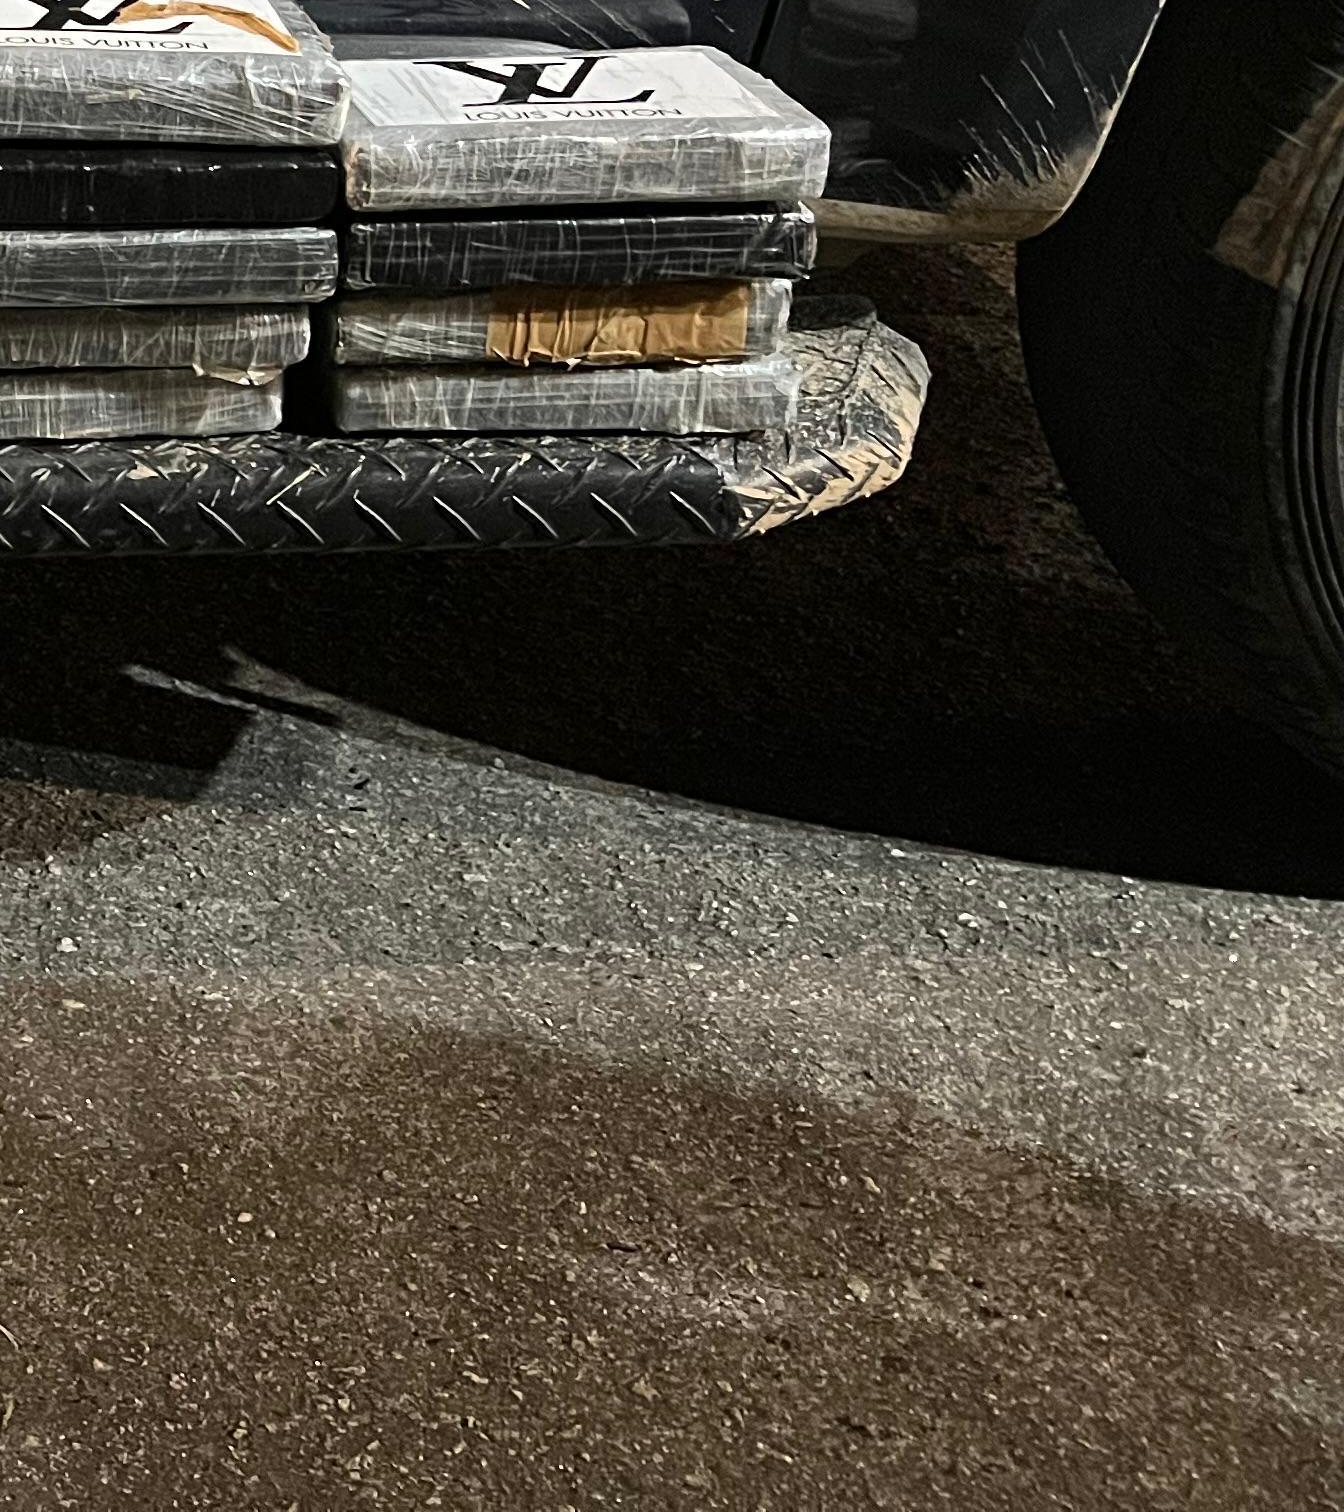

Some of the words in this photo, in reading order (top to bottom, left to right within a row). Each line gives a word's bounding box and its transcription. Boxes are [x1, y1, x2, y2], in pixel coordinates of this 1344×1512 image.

[81, 37, 210, 50] VUITTON
[463, 110, 548, 122] LOUIS
[551, 107, 683, 119] VUITTON
